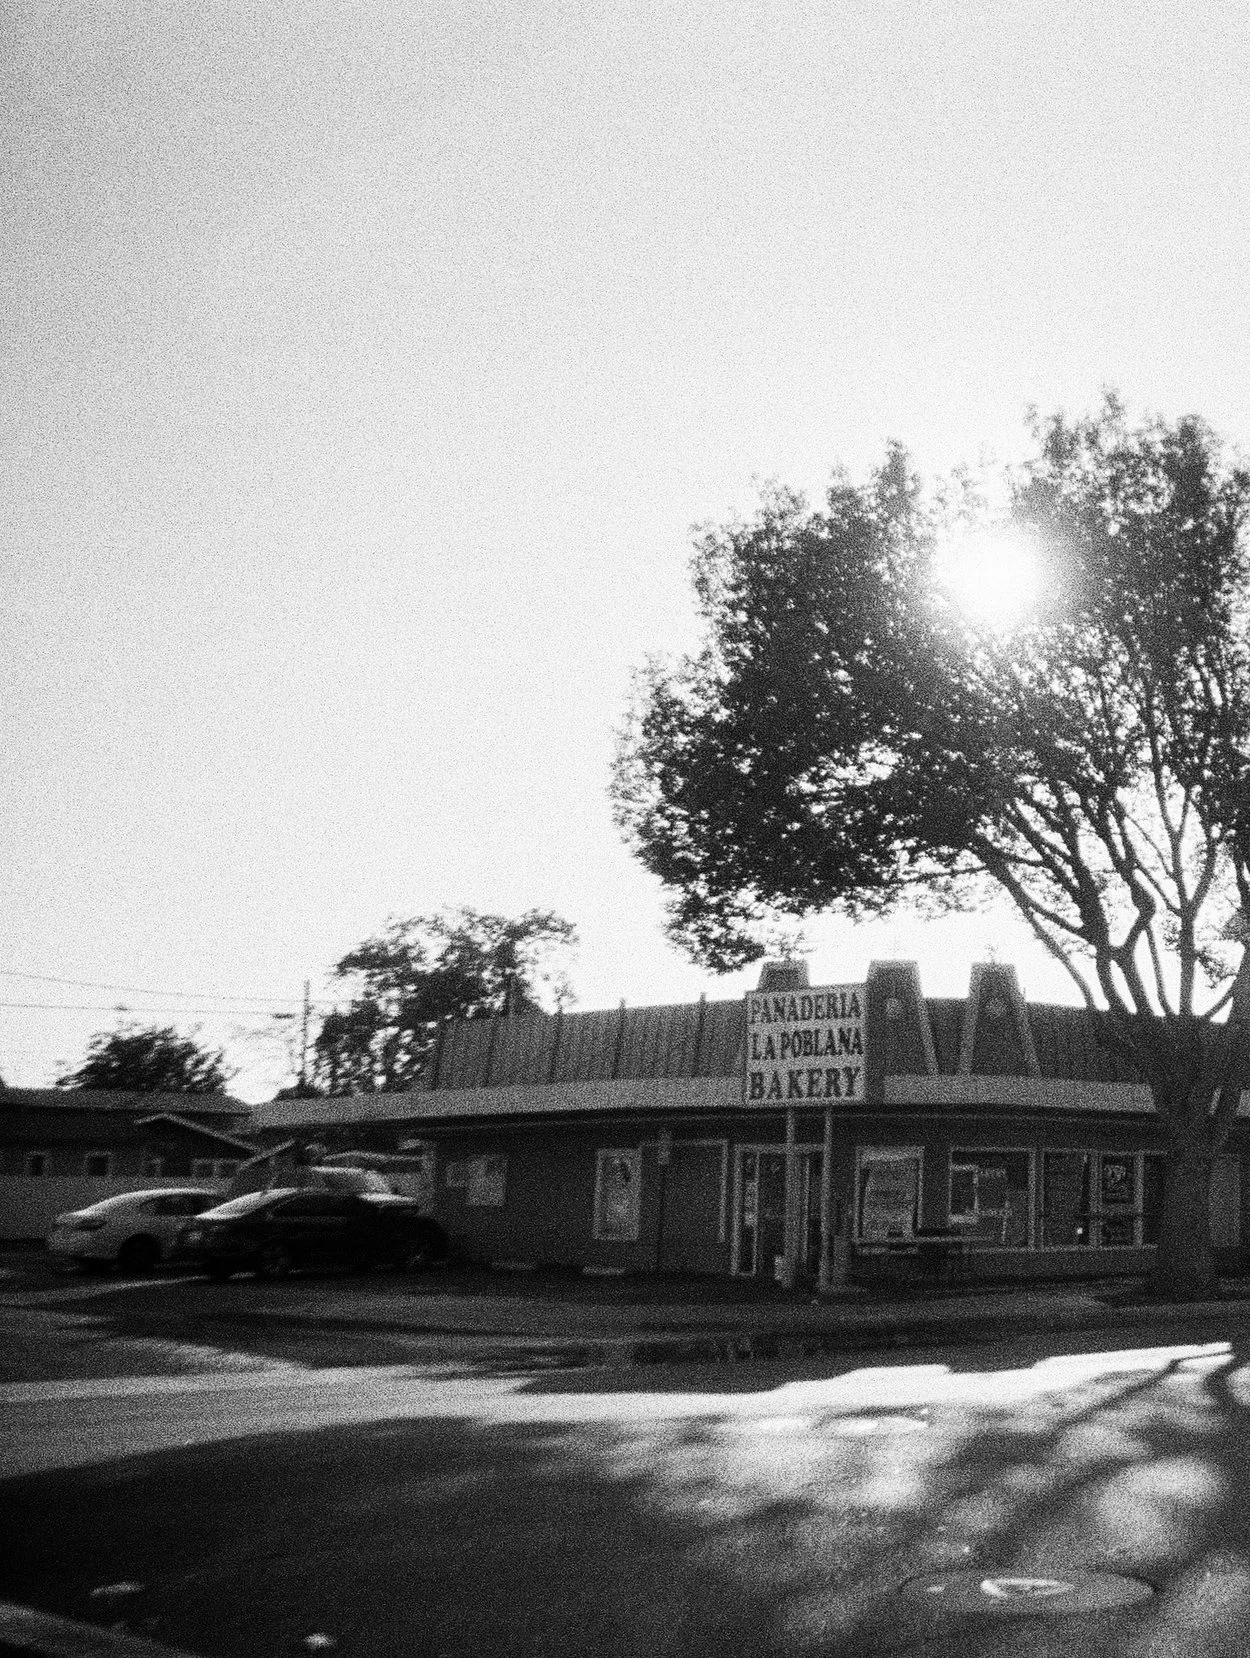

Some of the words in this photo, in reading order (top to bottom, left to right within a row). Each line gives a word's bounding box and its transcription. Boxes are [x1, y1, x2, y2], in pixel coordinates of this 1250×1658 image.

[750, 992, 861, 1024] PANADERIA
[751, 1033, 776, 1060] LA
[780, 1027, 864, 1060] POBLANA
[750, 1066, 861, 1099] BAKERY
